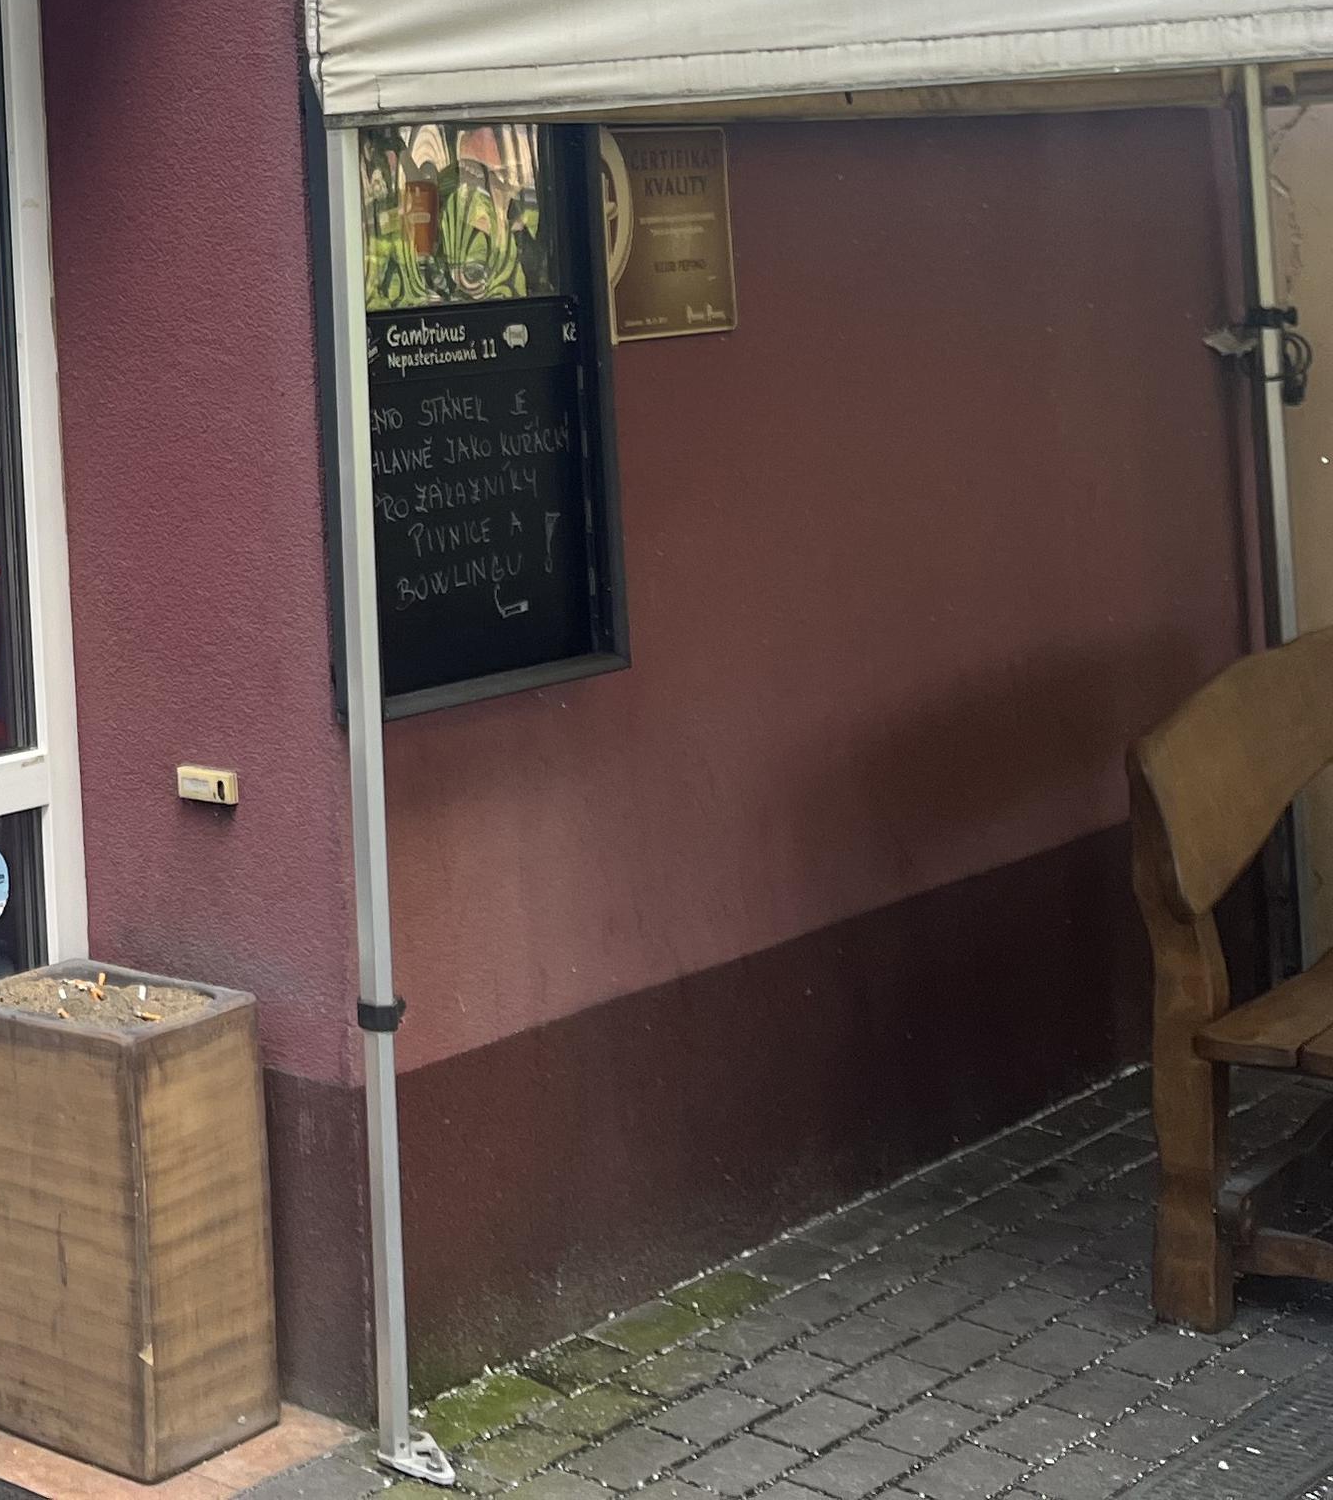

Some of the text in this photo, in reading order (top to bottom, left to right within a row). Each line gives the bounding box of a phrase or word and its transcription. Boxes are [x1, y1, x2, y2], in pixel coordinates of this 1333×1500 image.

[644, 174, 710, 197] KVALITY
[386, 318, 577, 347] Gambrinus Kč
[387, 341, 478, 378] Nepasterizovaná
[482, 338, 498, 359] 11
[417, 389, 489, 427] STÁNEK
[443, 434, 492, 464] JAKO
[407, 517, 492, 558] PIVNICE
[510, 510, 523, 536] A
[395, 552, 523, 611] BOWLINGU
